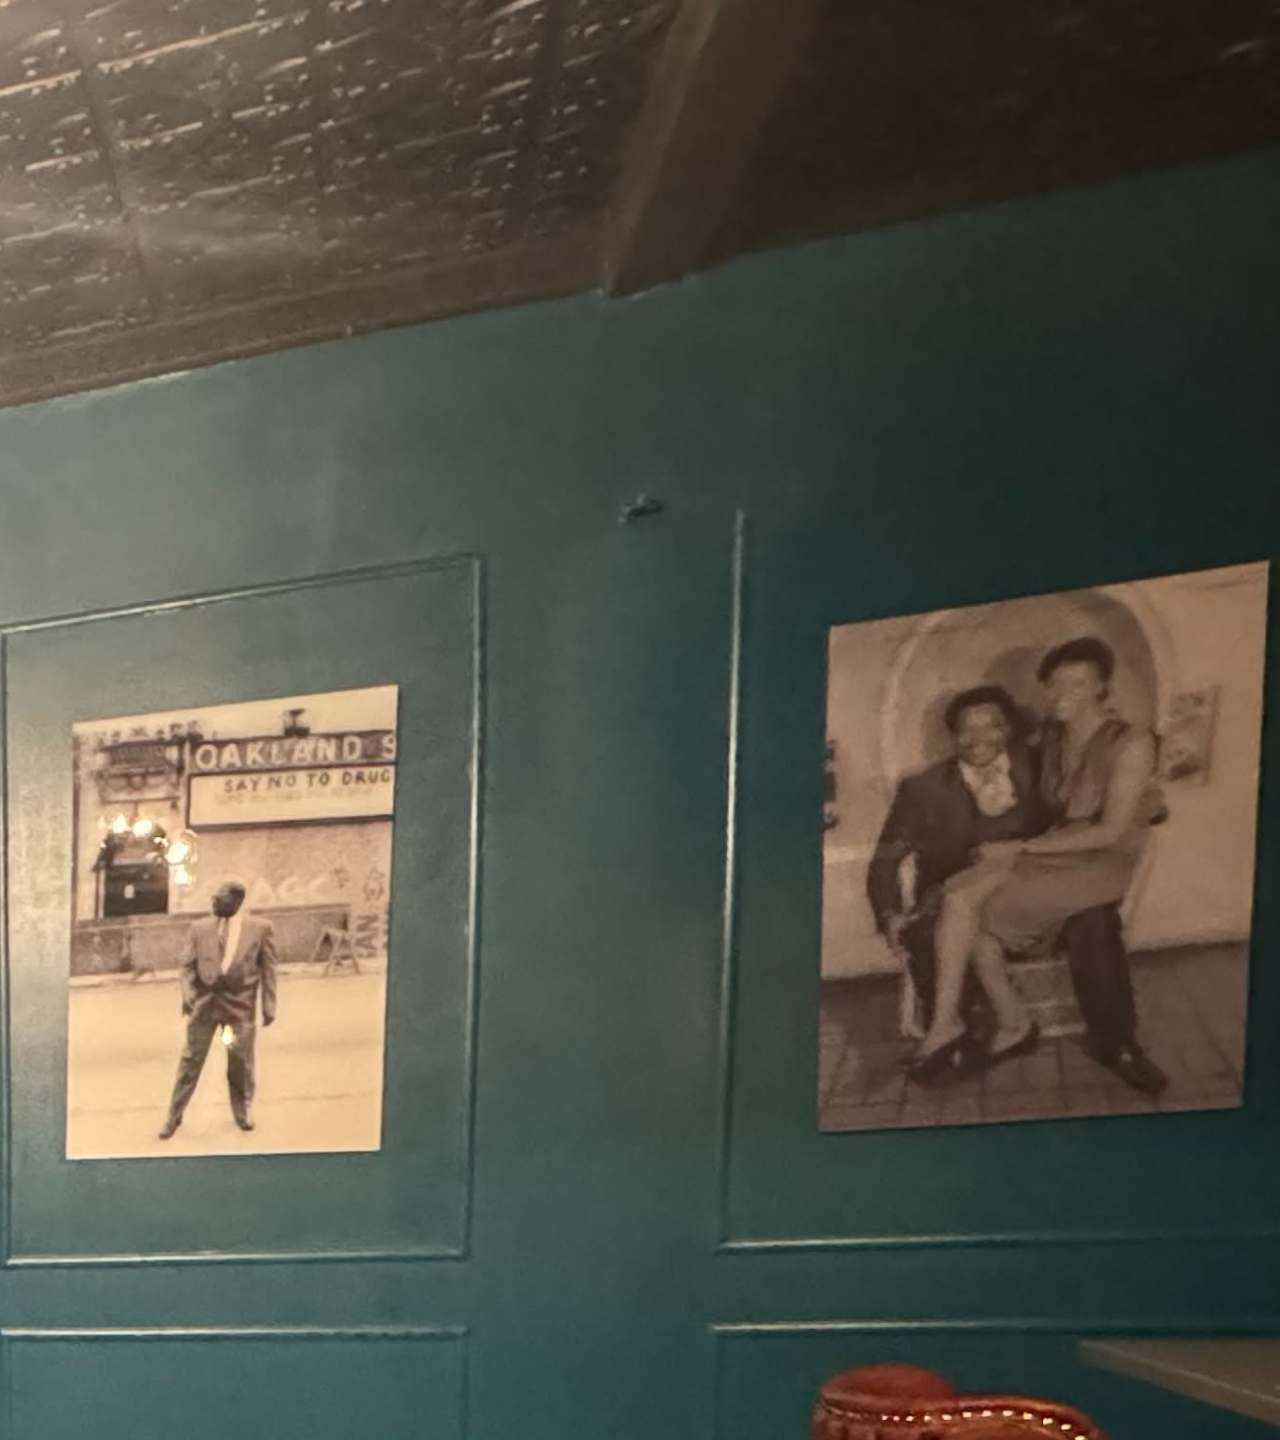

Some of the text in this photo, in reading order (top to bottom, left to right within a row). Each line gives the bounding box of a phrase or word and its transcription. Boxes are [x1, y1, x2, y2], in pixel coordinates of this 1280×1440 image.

[195, 734, 362, 769] OAKLAND
[224, 778, 259, 793] SAY
[267, 774, 296, 789] NO
[306, 771, 330, 786] TO
